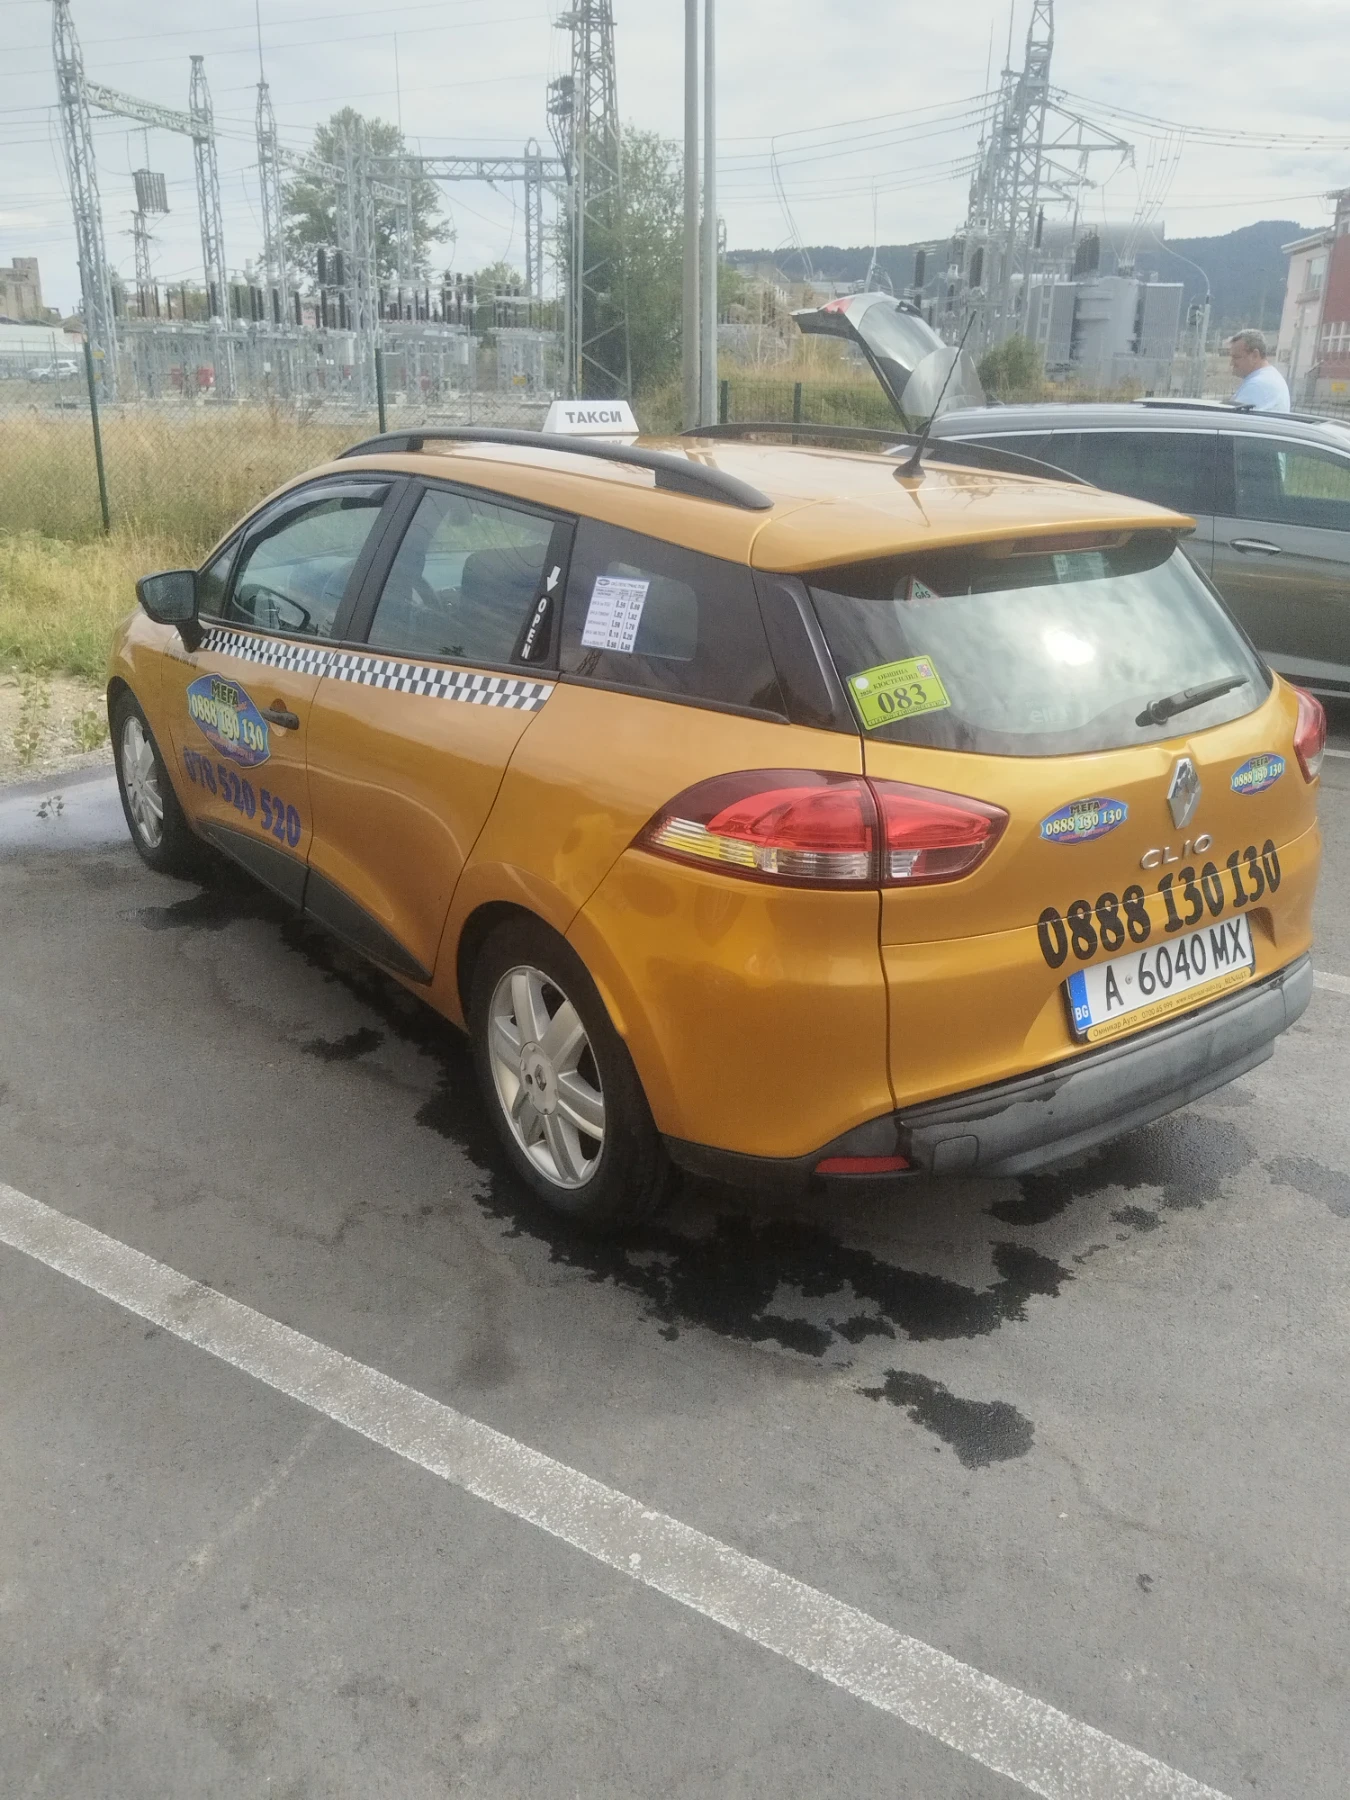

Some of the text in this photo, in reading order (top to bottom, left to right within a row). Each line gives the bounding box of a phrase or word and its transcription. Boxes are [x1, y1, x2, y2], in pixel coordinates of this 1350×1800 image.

[565, 411, 622, 424] ТАКСИ
[915, 591, 931, 599] GAS
[521, 598, 547, 659] OPEN
[211, 679, 239, 706] МЕГА
[877, 683, 927, 714] 083
[191, 694, 219, 727] 0888
[242, 718, 264, 751] 130
[217, 763, 256, 820] 520
[260, 787, 301, 848] 520
[1070, 801, 1100, 814] МЕГА
[1046, 817, 1075, 836] 0888
[1078, 813, 1099, 830] 130
[1102, 808, 1122, 824] 130
[1139, 834, 1213, 870] CLIO
[1037, 839, 1281, 969] 0888 130 130
[1138, 933, 1207, 996] 6040
[1075, 1006, 1089, 1022] BG
[1122, 1015, 1137, 1028] Ауто
